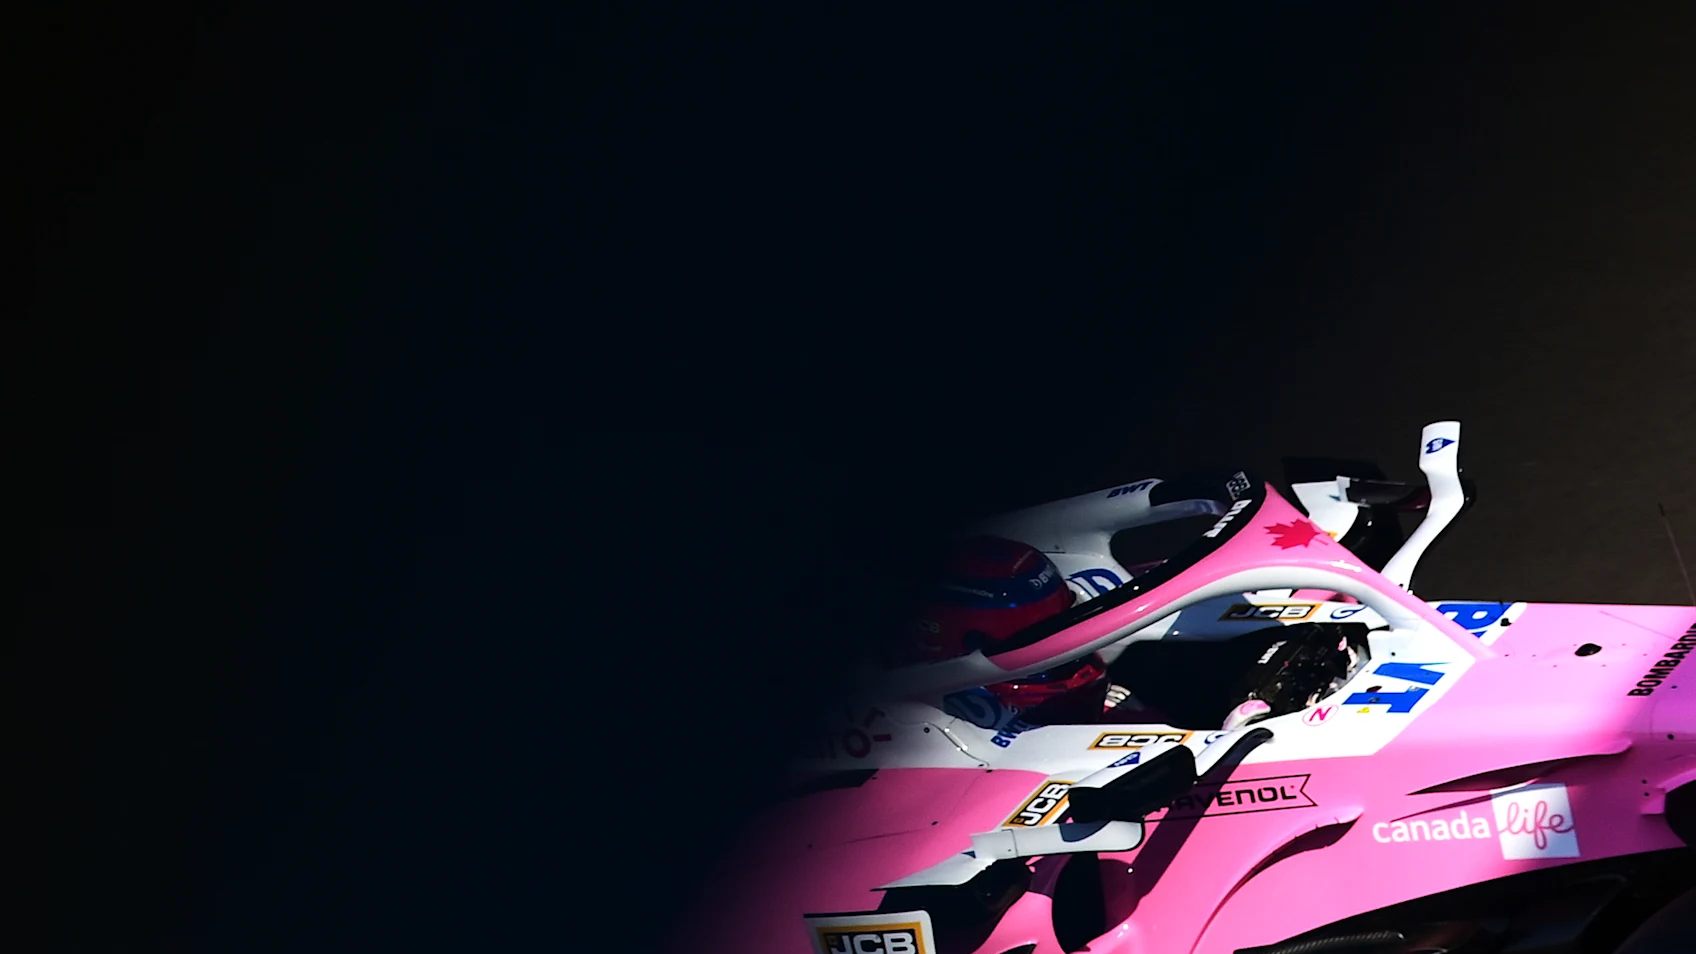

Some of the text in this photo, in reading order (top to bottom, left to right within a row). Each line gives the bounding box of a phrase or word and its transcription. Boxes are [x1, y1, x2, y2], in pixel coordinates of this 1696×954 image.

[1229, 605, 1314, 619] JCB
[1308, 707, 1330, 722] N
[1097, 734, 1182, 746] JCB
[1019, 783, 1069, 826] JCB
[1172, 786, 1297, 811] AVENOL
[1372, 800, 1574, 851] canada life
